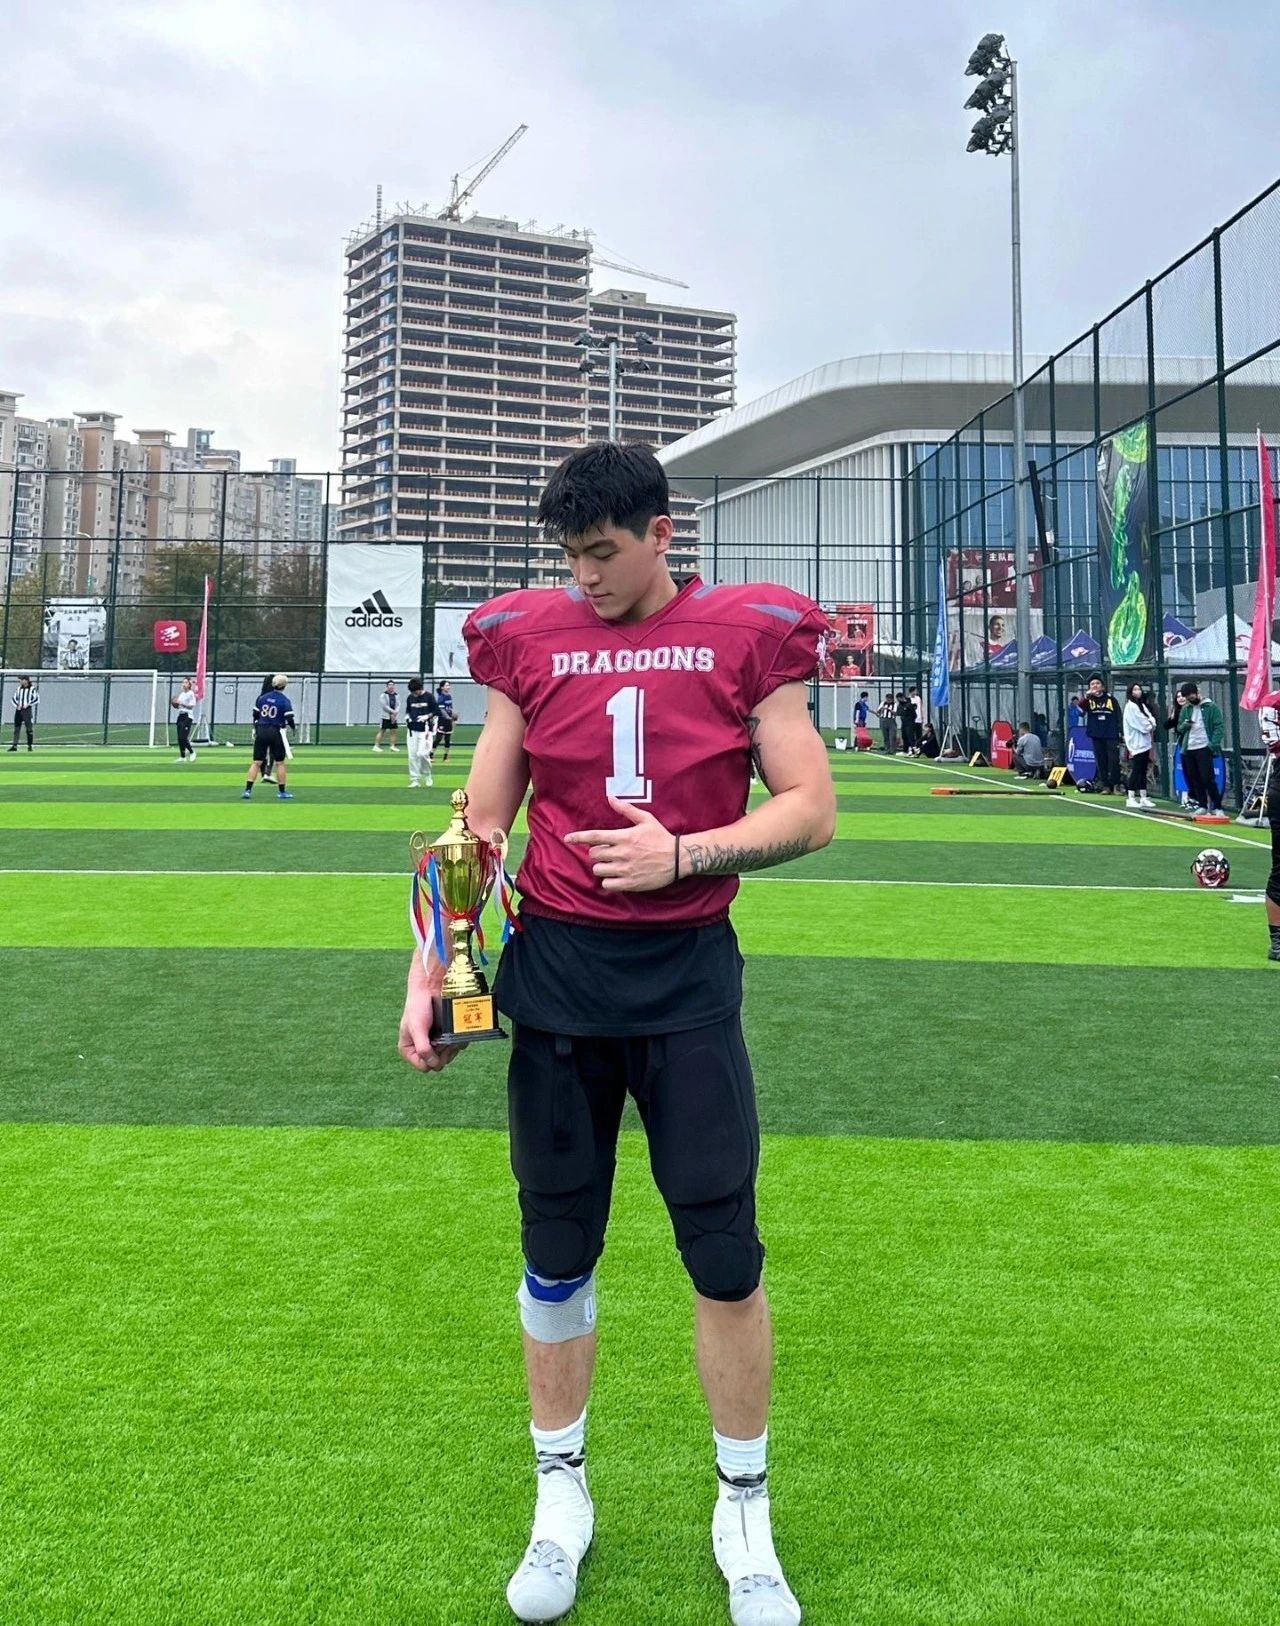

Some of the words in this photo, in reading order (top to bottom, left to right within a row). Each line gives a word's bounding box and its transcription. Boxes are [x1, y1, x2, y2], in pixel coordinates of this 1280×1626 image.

[345, 613, 403, 627] adidas
[551, 645, 715, 678] DRAGOONS
[260, 704, 278, 719] 80
[606, 685, 652, 803] 1
